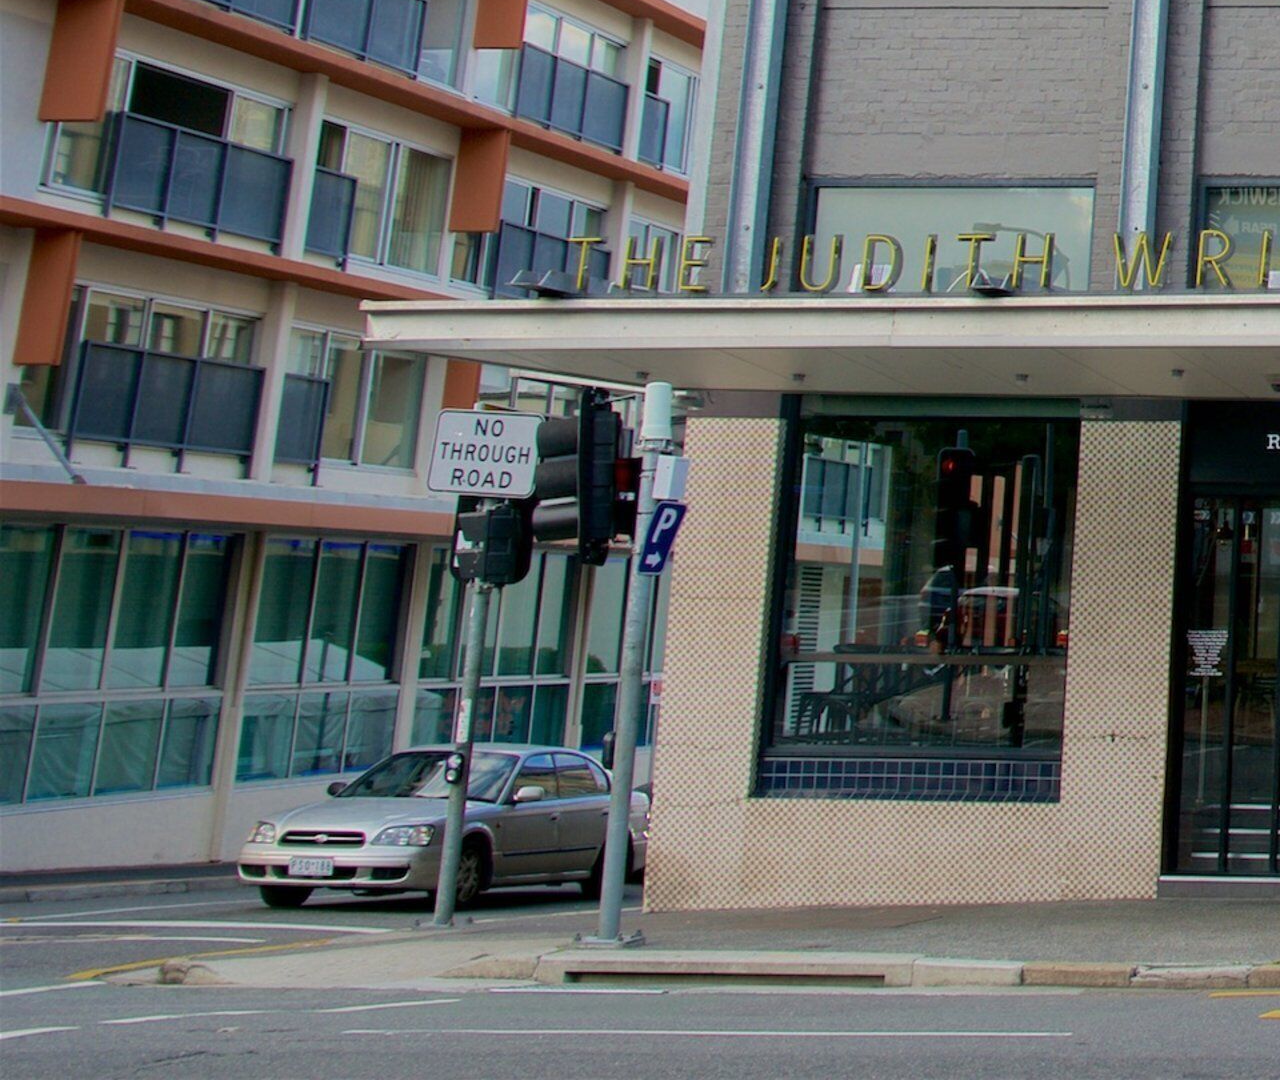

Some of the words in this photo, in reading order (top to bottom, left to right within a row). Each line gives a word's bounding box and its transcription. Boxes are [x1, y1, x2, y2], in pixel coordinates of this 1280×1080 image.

[569, 234, 714, 293] THE
[760, 232, 1057, 293] JUDITH
[474, 418, 504, 437] NO
[440, 441, 532, 466] THROUGH
[450, 467, 514, 490] ROAD
[652, 507, 678, 544] P
